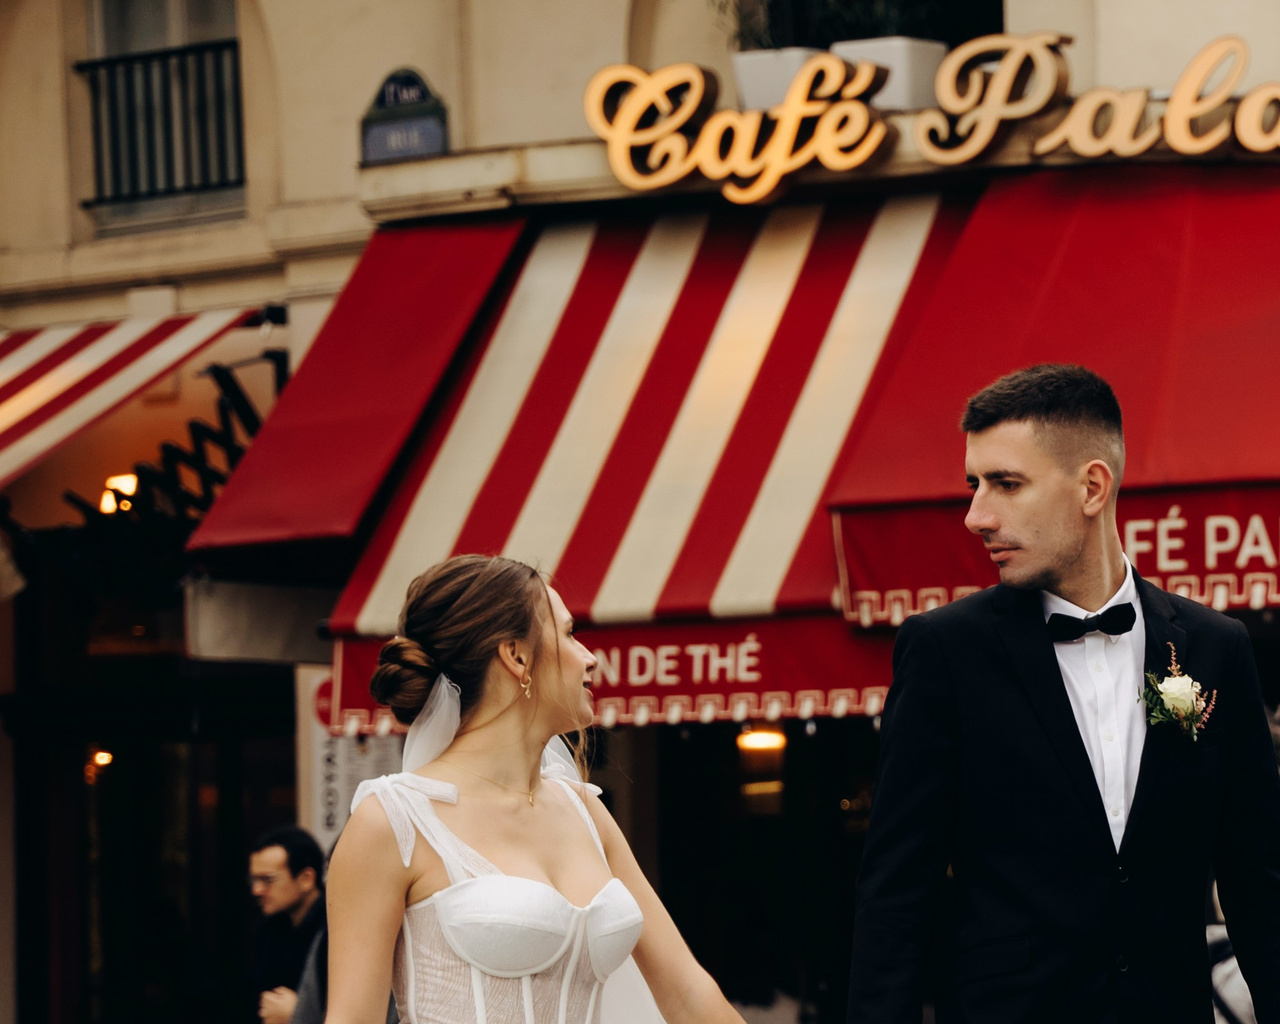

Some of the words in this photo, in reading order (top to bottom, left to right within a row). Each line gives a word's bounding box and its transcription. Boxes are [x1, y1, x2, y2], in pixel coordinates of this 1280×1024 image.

[584, 53, 888, 204] Café
[1124, 505, 1188, 572] FÉ
[628, 645, 680, 686] DE
[685, 633, 762, 684] THÉ
